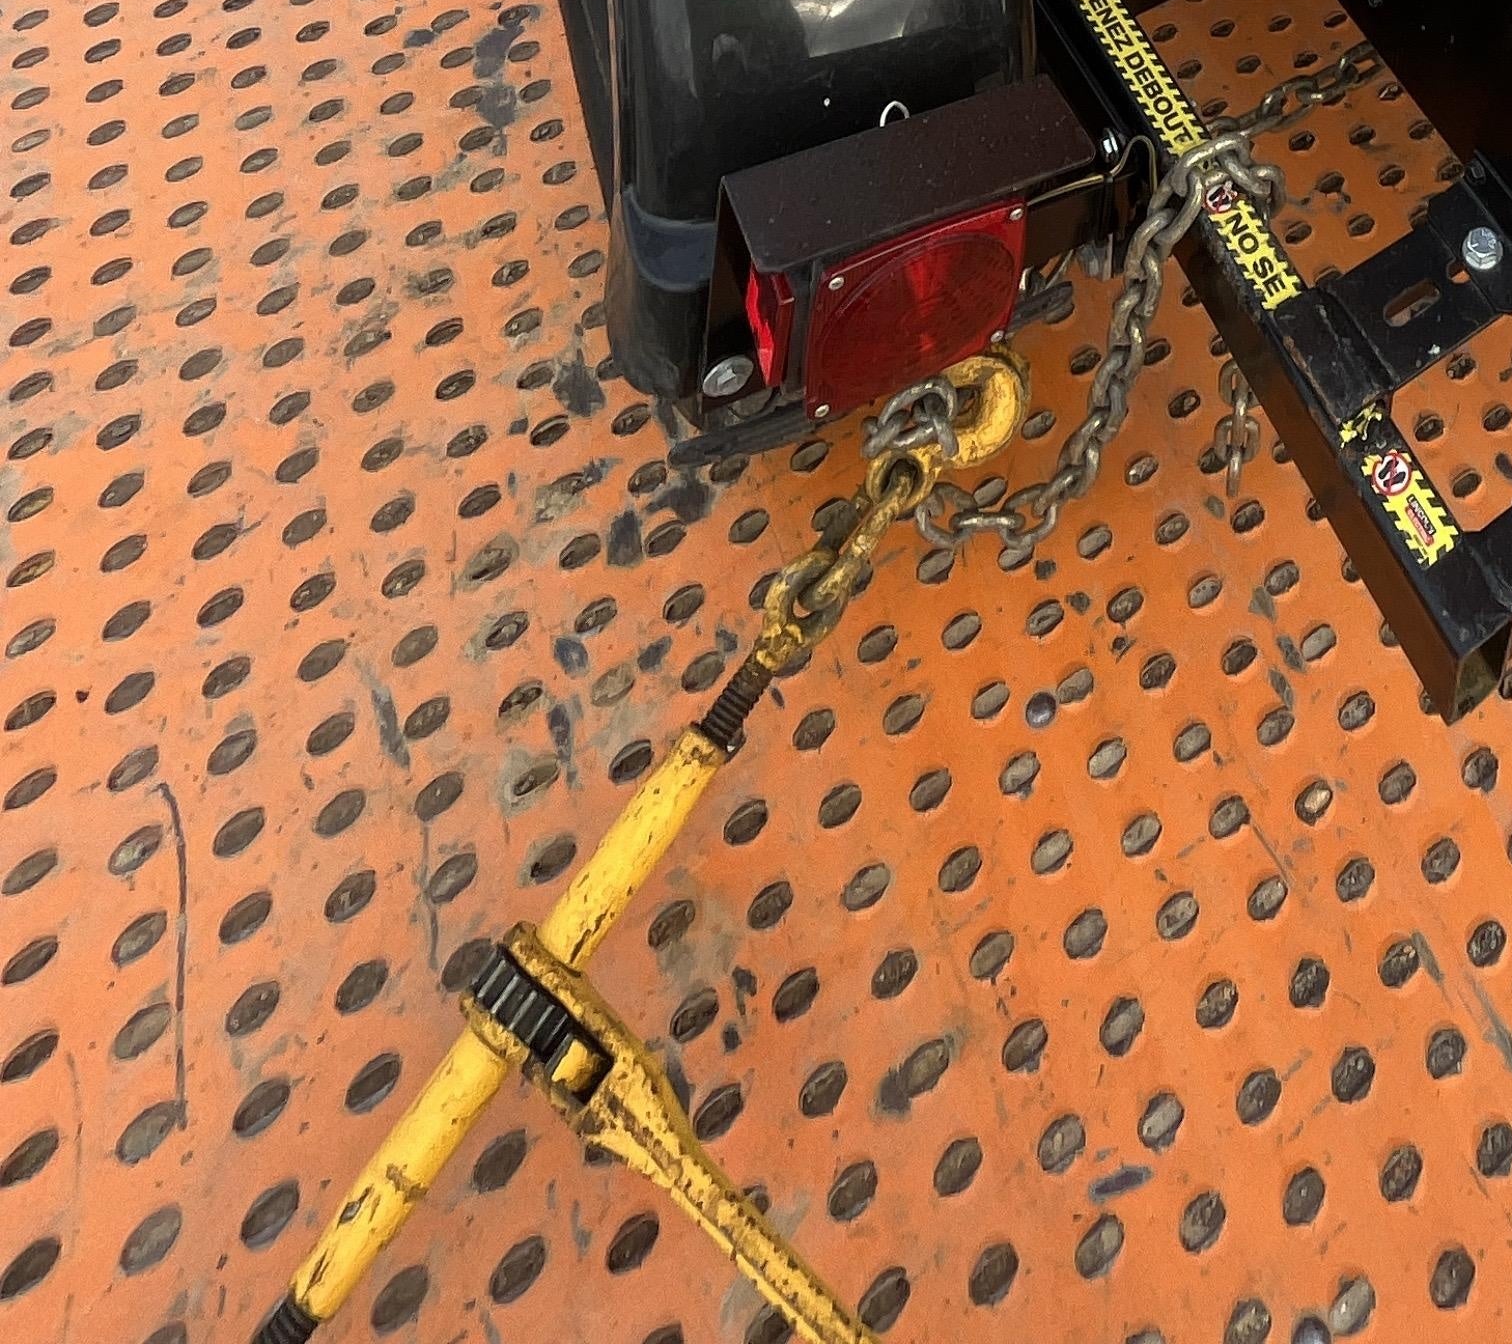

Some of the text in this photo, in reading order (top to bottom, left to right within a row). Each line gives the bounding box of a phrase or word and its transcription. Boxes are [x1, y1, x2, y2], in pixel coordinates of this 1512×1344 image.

[1124, 51, 1194, 145] DEBOUT
[1224, 212, 1286, 297] NO SE
